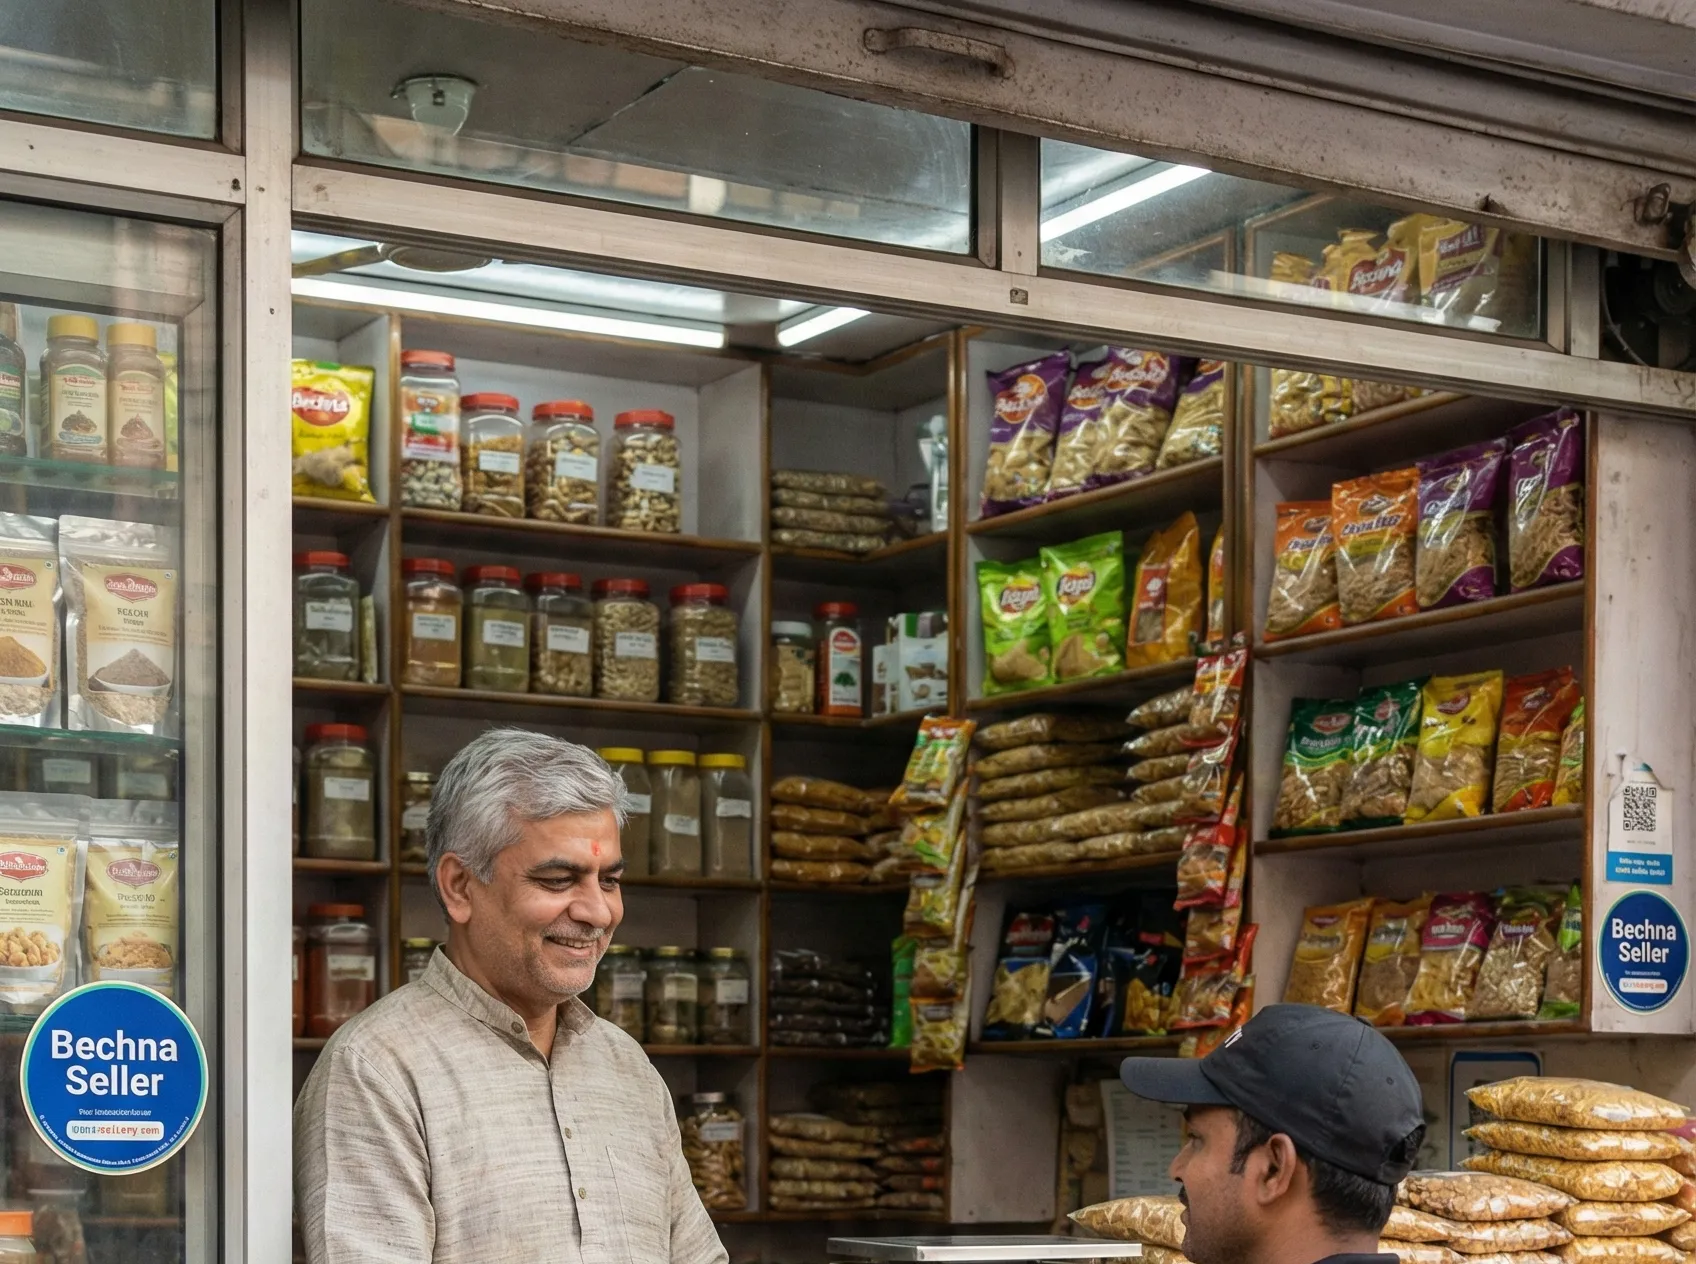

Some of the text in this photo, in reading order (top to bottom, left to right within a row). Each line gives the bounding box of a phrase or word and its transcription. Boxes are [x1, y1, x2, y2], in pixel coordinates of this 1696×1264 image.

[1612, 918, 1676, 940] Bechna
[1619, 942, 1669, 963] Seller
[51, 1029, 178, 1061] Bechna
[66, 1064, 164, 1096] Seller
